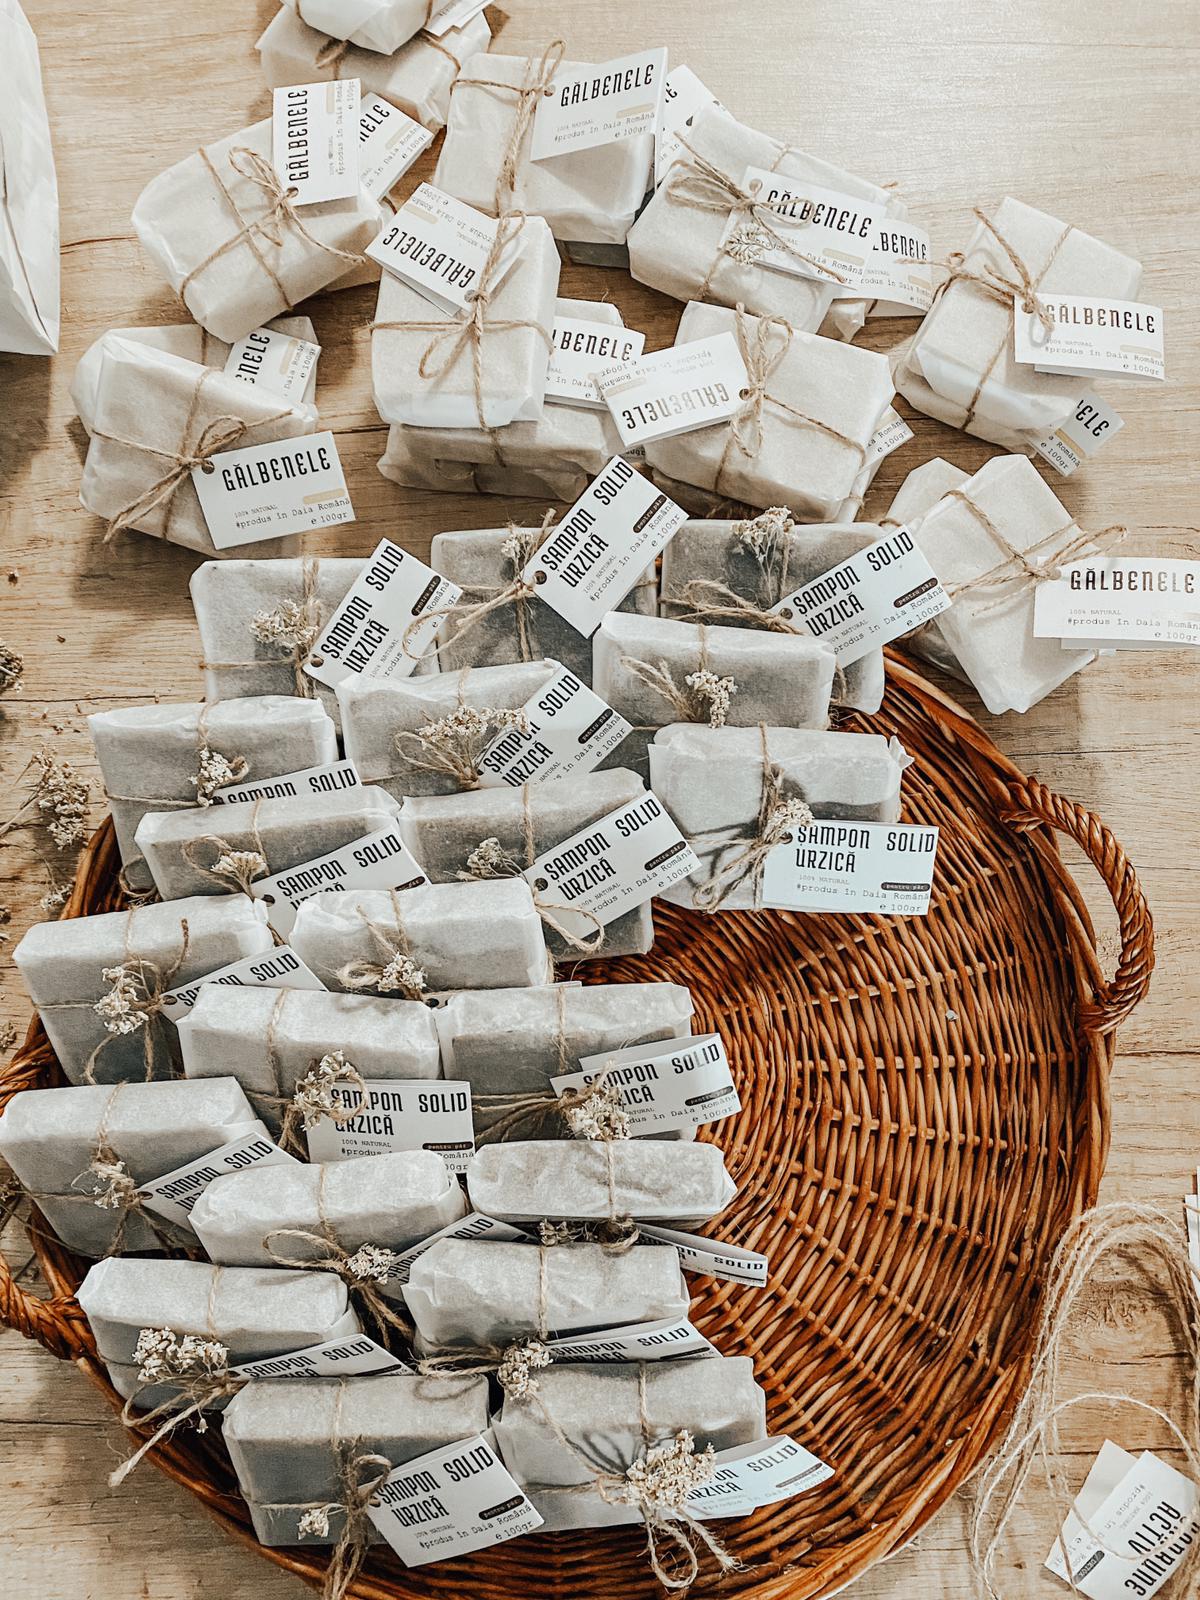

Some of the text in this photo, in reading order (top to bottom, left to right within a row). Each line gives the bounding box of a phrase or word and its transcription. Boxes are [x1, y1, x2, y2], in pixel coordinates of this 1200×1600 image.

[561, 63, 654, 107] GĂLBENELE
[286, 90, 309, 181] GĂLBENELE
[382, 227, 476, 288] GĂLBENELE
[873, 232, 927, 260] BENELE
[1046, 303, 1155, 333] GĂLBENELE
[552, 329, 633, 361] BENELE
[222, 447, 331, 491] GĂLBENELE
[593, 461, 634, 506] SOLID
[293, 507, 314, 517] Daia
[320, 512, 348, 523] 100gr
[657, 515, 680, 539] 100gr
[630, 533, 649, 553] Daia
[866, 531, 914, 572] SOLID
[365, 545, 404, 592] SOLID
[559, 533, 609, 588] URZICĂ
[1070, 567, 1195, 594] GĂLBENELE
[805, 591, 865, 637] URZICĂ
[916, 601, 945, 622] 100gr
[343, 618, 390, 674] URZICĂ
[833, 632, 865, 655] produs
[884, 609, 907, 625] Daia
[383, 651, 403, 678] rodus
[538, 674, 580, 717] SOLID
[574, 743, 594, 762] Daia
[604, 728, 626, 751] 100gr
[502, 741, 553, 787] URZICĂ
[308, 767, 357, 793] SOLID
[615, 798, 661, 837] SOLID
[353, 833, 402, 868] SOLID
[886, 831, 935, 853] SOLID
[667, 864, 694, 883] 100gr
[796, 848, 856, 873] URZICĂ
[558, 857, 616, 901] URZICĂ
[635, 872, 658, 888] Daia
[862, 889, 887, 899] Daia
[890, 904, 921, 913] 100gr
[250, 953, 299, 982] SOLID
[583, 1043, 720, 1090] SMPON SOLID
[418, 1092, 468, 1113] SOLID
[224, 1140, 273, 1169] SOLID
[714, 1256, 763, 1270] SOLID
[321, 1340, 374, 1361] SOLID
[637, 1327, 690, 1347] SOLID
[443, 1445, 494, 1482] SOLID
[747, 1444, 798, 1472] SOLID
[391, 1495, 450, 1528] URZICĂ
[471, 1523, 494, 1534] Daia
[503, 1520, 534, 1538] 100gr
[1128, 1501, 1181, 1555] ACTIV
